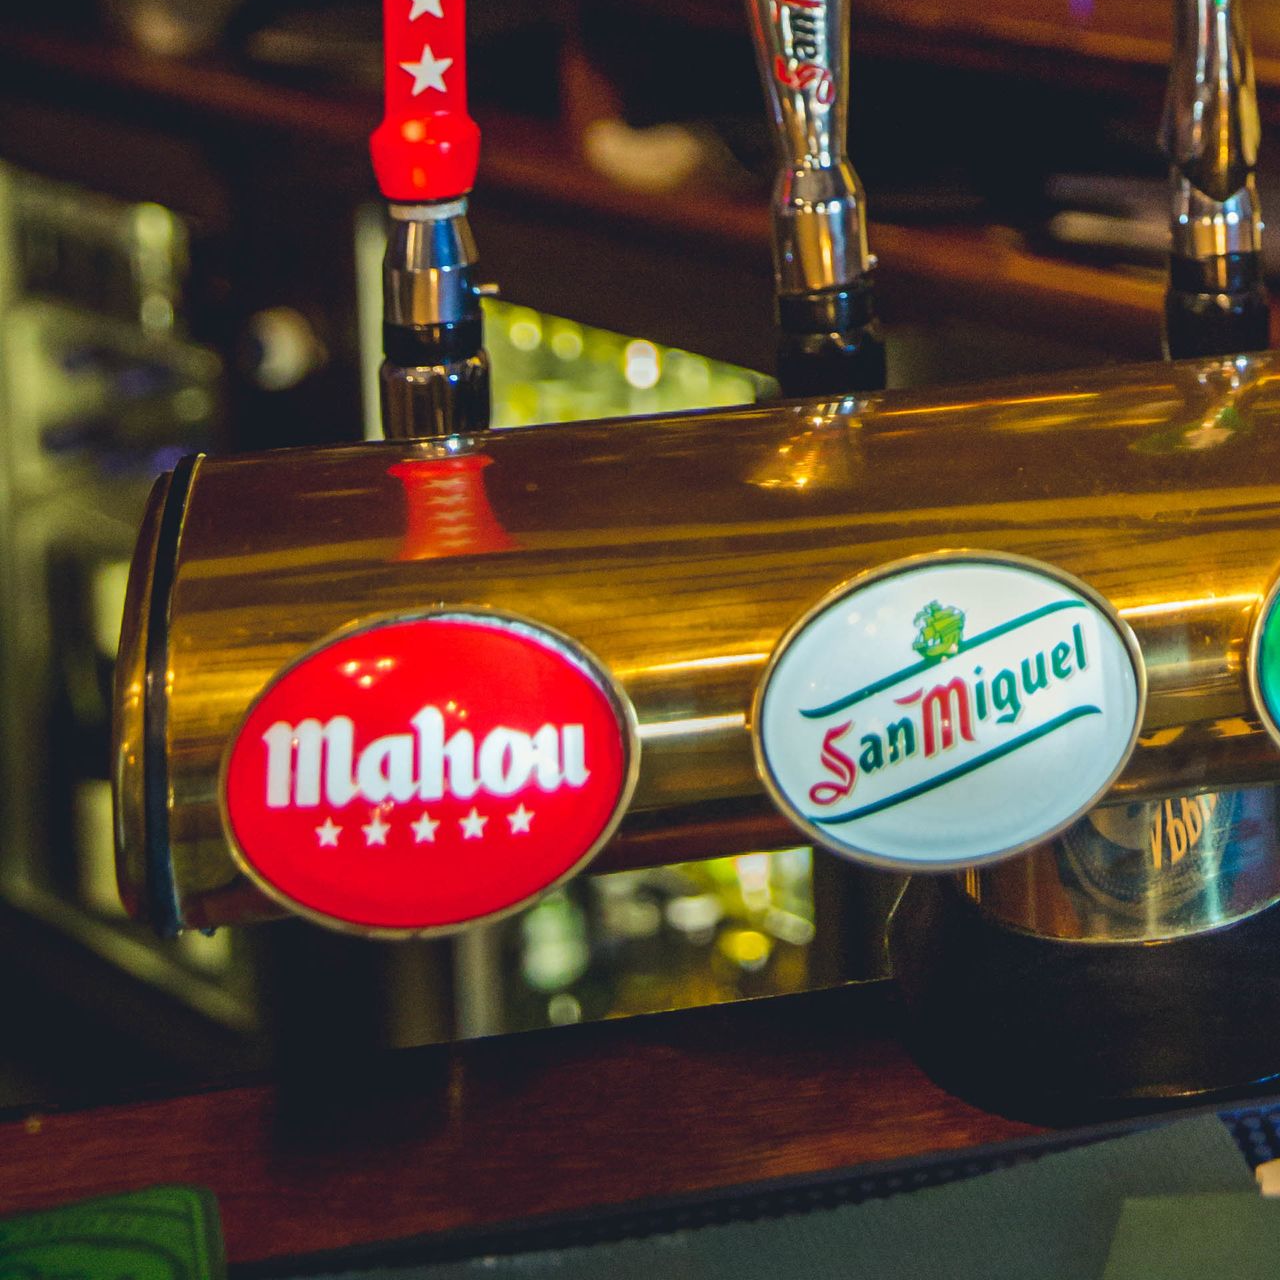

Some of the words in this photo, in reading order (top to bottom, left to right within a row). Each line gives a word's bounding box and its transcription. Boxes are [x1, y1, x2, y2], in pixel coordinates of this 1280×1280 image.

[262, 704, 592, 809] Mahou
[808, 717, 916, 806] San
[894, 623, 1088, 758] Miguel
